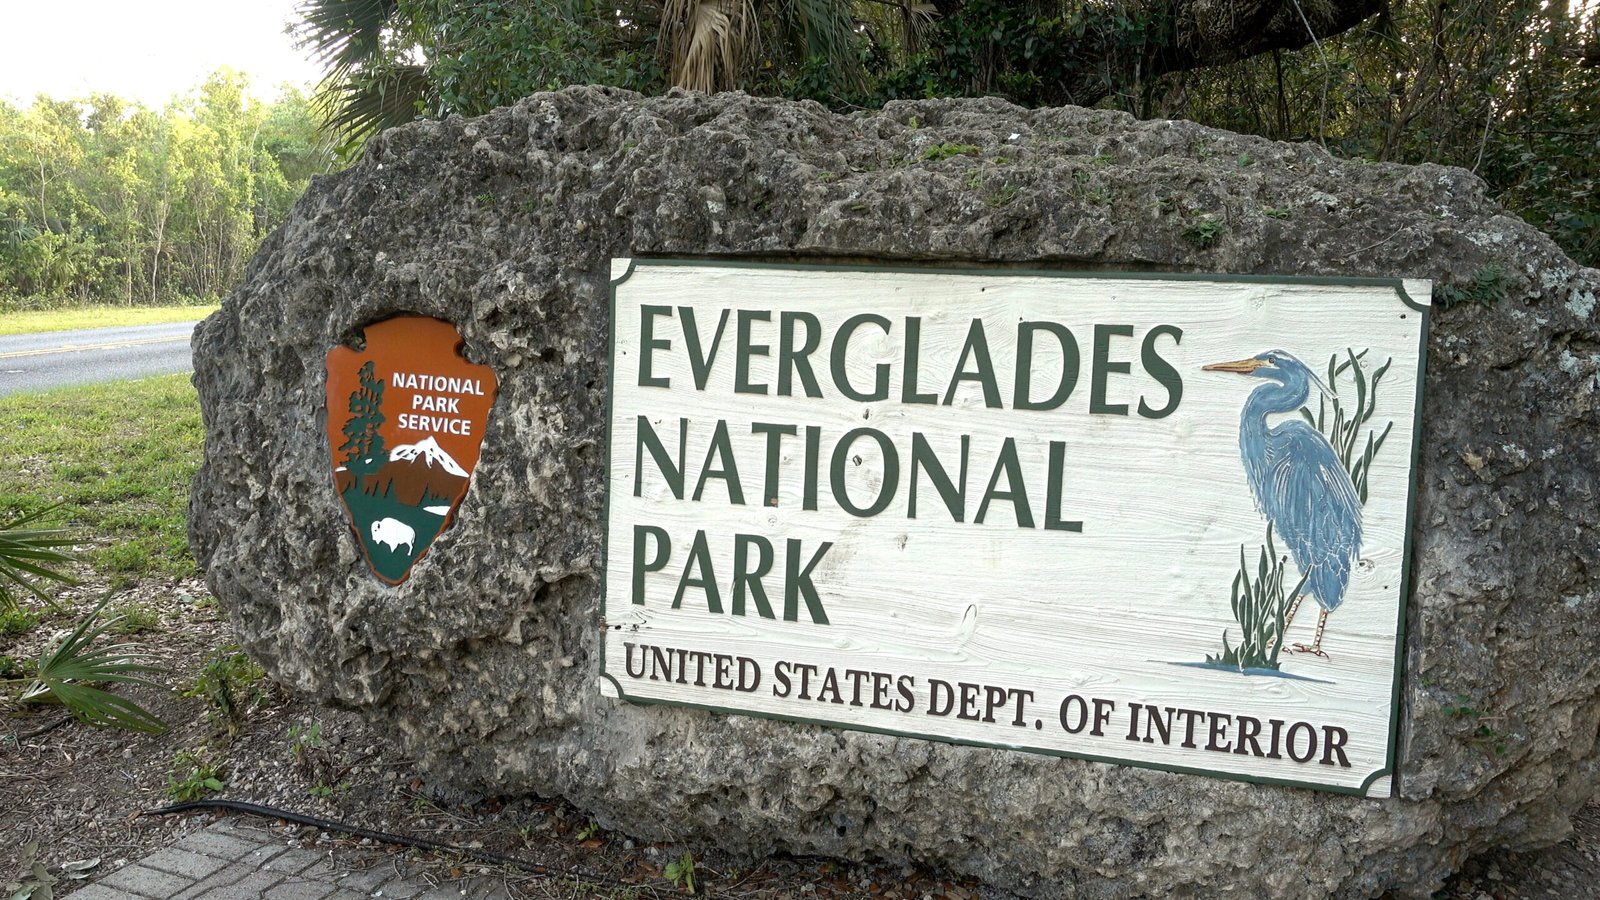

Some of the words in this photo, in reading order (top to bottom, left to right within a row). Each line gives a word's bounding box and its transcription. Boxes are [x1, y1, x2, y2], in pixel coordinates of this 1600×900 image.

[392, 372, 485, 396] NATIONAL
[411, 394, 460, 414] PARK
[637, 304, 1185, 418] EVERGLADES
[398, 413, 472, 436] SERVICE
[633, 415, 1083, 533] NATIONAL
[631, 524, 834, 626] PARK
[624, 642, 762, 693] UNITED
[772, 660, 915, 714] STATES
[926, 678, 1043, 731] DEPT.
[1059, 694, 1115, 737] OF
[1125, 702, 1352, 769] INTERIOR
